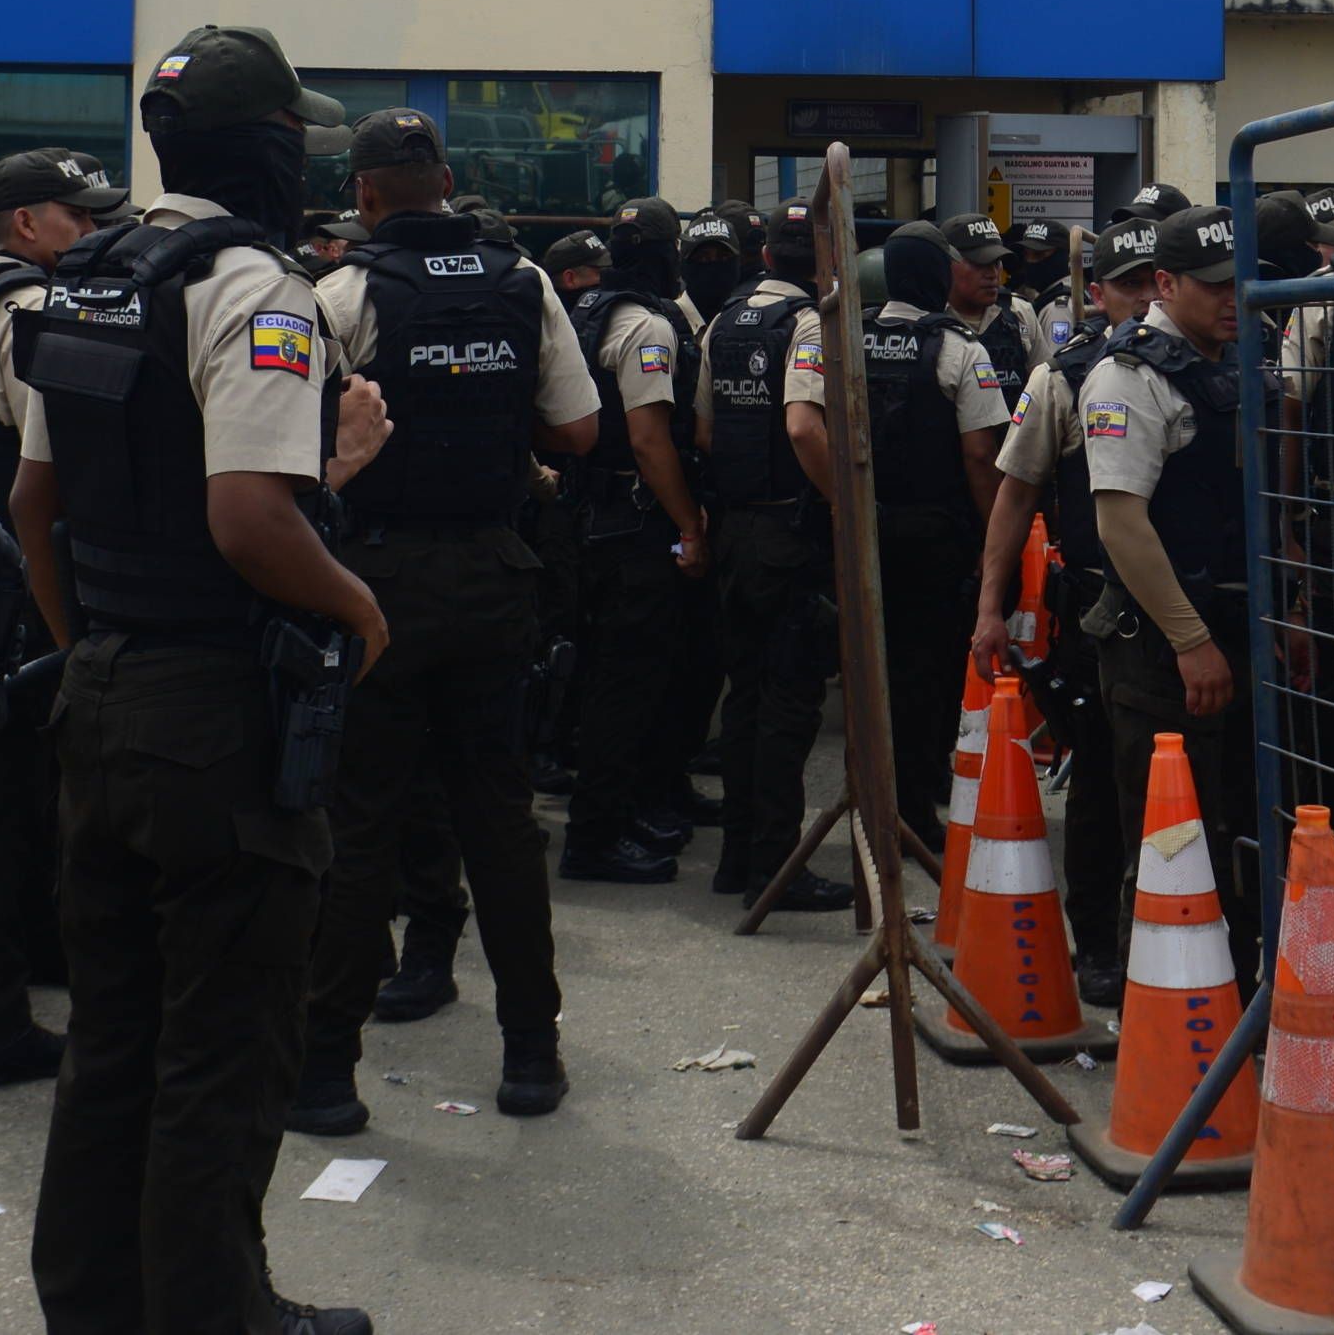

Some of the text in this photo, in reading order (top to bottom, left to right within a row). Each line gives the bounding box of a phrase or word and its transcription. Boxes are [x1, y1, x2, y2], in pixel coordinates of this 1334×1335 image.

[1018, 189, 1054, 197] GORRAS
[93, 312, 141, 325] ECUADOR
[410, 339, 516, 366] POLICIA
[871, 350, 917, 360] NACIONAL
[468, 360, 517, 373] NACIONAL
[713, 379, 770, 395] POLICIA
[731, 396, 771, 405] NACIONAL
[1012, 900, 1044, 1022] POLICIA
